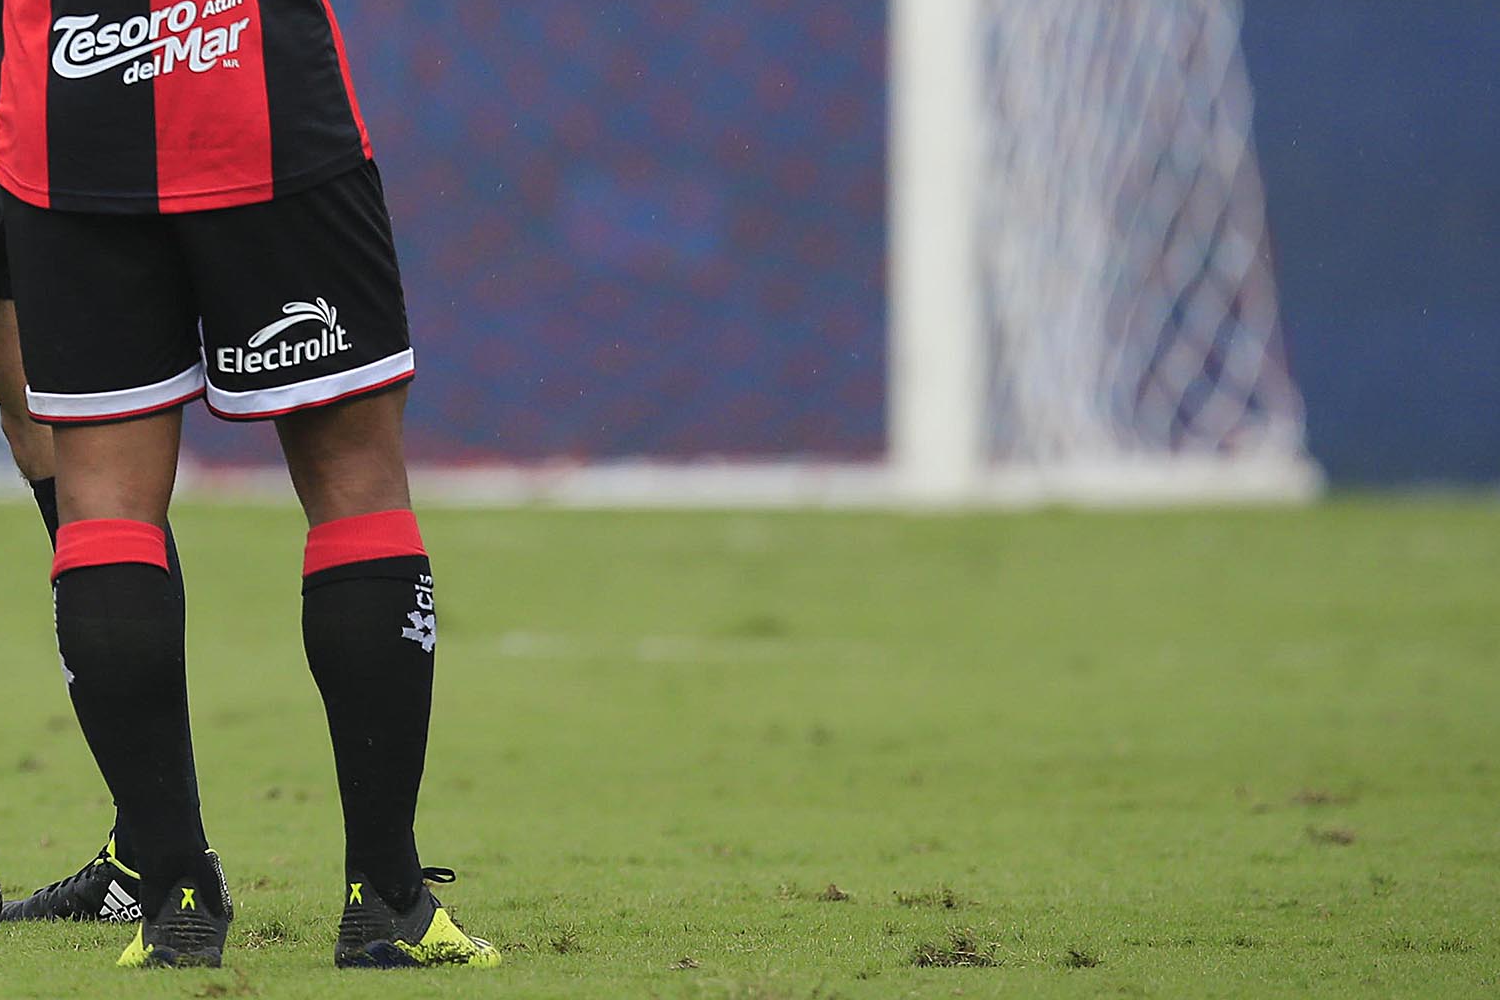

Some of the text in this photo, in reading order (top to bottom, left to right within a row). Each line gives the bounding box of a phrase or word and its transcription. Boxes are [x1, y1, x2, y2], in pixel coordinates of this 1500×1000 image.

[51, 0, 198, 79] Tesoro
[122, 55, 160, 85] del
[161, 17, 250, 73] Mar
